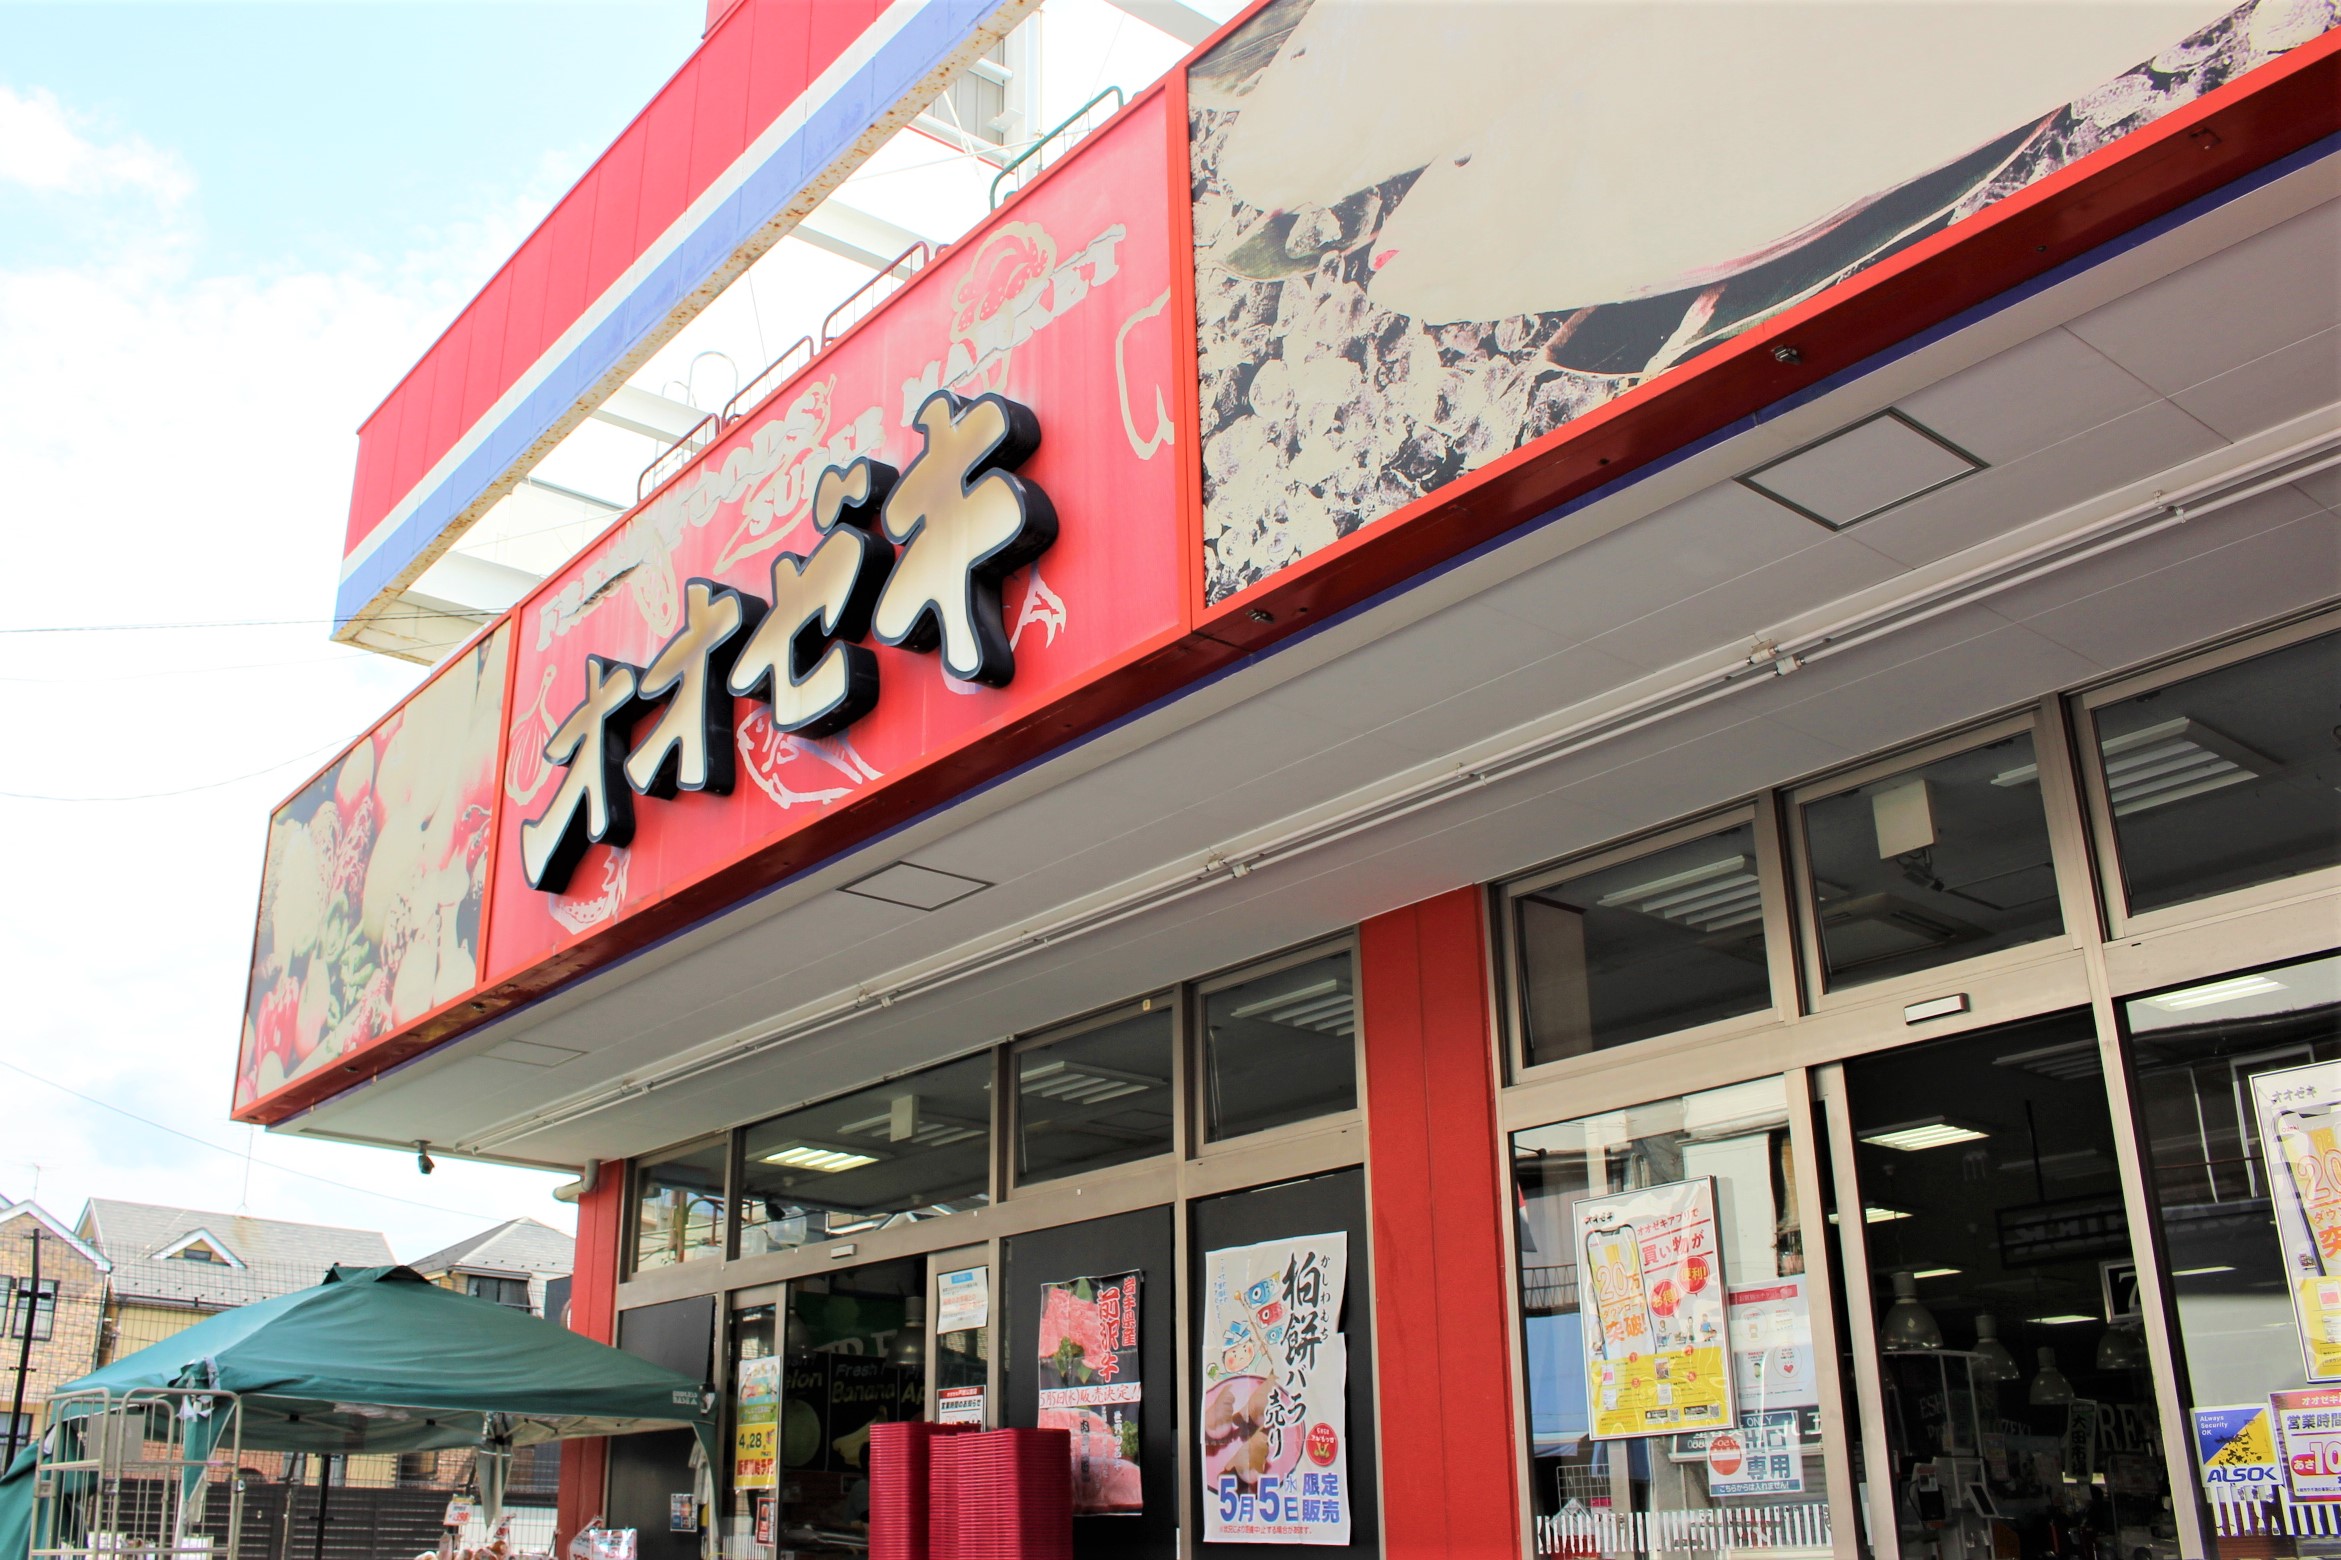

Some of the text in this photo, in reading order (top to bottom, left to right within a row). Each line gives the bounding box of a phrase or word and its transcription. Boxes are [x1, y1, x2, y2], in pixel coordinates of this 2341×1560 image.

[901, 223, 1126, 428] MARKET
[520, 389, 1058, 893] オオゼキ
[2271, 1084, 2317, 1104] オオゼキ
[1637, 1207, 1699, 1236] オオゼキアプリで
[2314, 1206, 2341, 1225] ダウ
[1642, 1229, 1705, 1266] 買い物が
[1596, 1261, 1641, 1302] 20万
[1122, 1276, 1136, 1347] 岩手県産
[1320, 1254, 1331, 1341] かしわもち
[1097, 1286, 1120, 1383] 前沢牛
[1281, 1251, 1323, 1425] 柏餅バラ
[1605, 1312, 1648, 1345] 突破!
[831, 1380, 896, 1403] Banana
[1265, 1389, 1286, 1459] 売り
[1746, 1415, 1773, 1427] ONLY
[2287, 1412, 2341, 1430] 営業時間
[1745, 1454, 1792, 1481] 専用
[2206, 1466, 2278, 1483] ALSOK
[2293, 1459, 2315, 1471] あさ
[1285, 1475, 1298, 1493] 水
[1302, 1472, 1340, 1496] 限定
[1718, 1482, 1790, 1493] こちらからは入れません!
[1219, 1476, 1299, 1523] 5月5日
[1302, 1499, 1341, 1523] 販売
